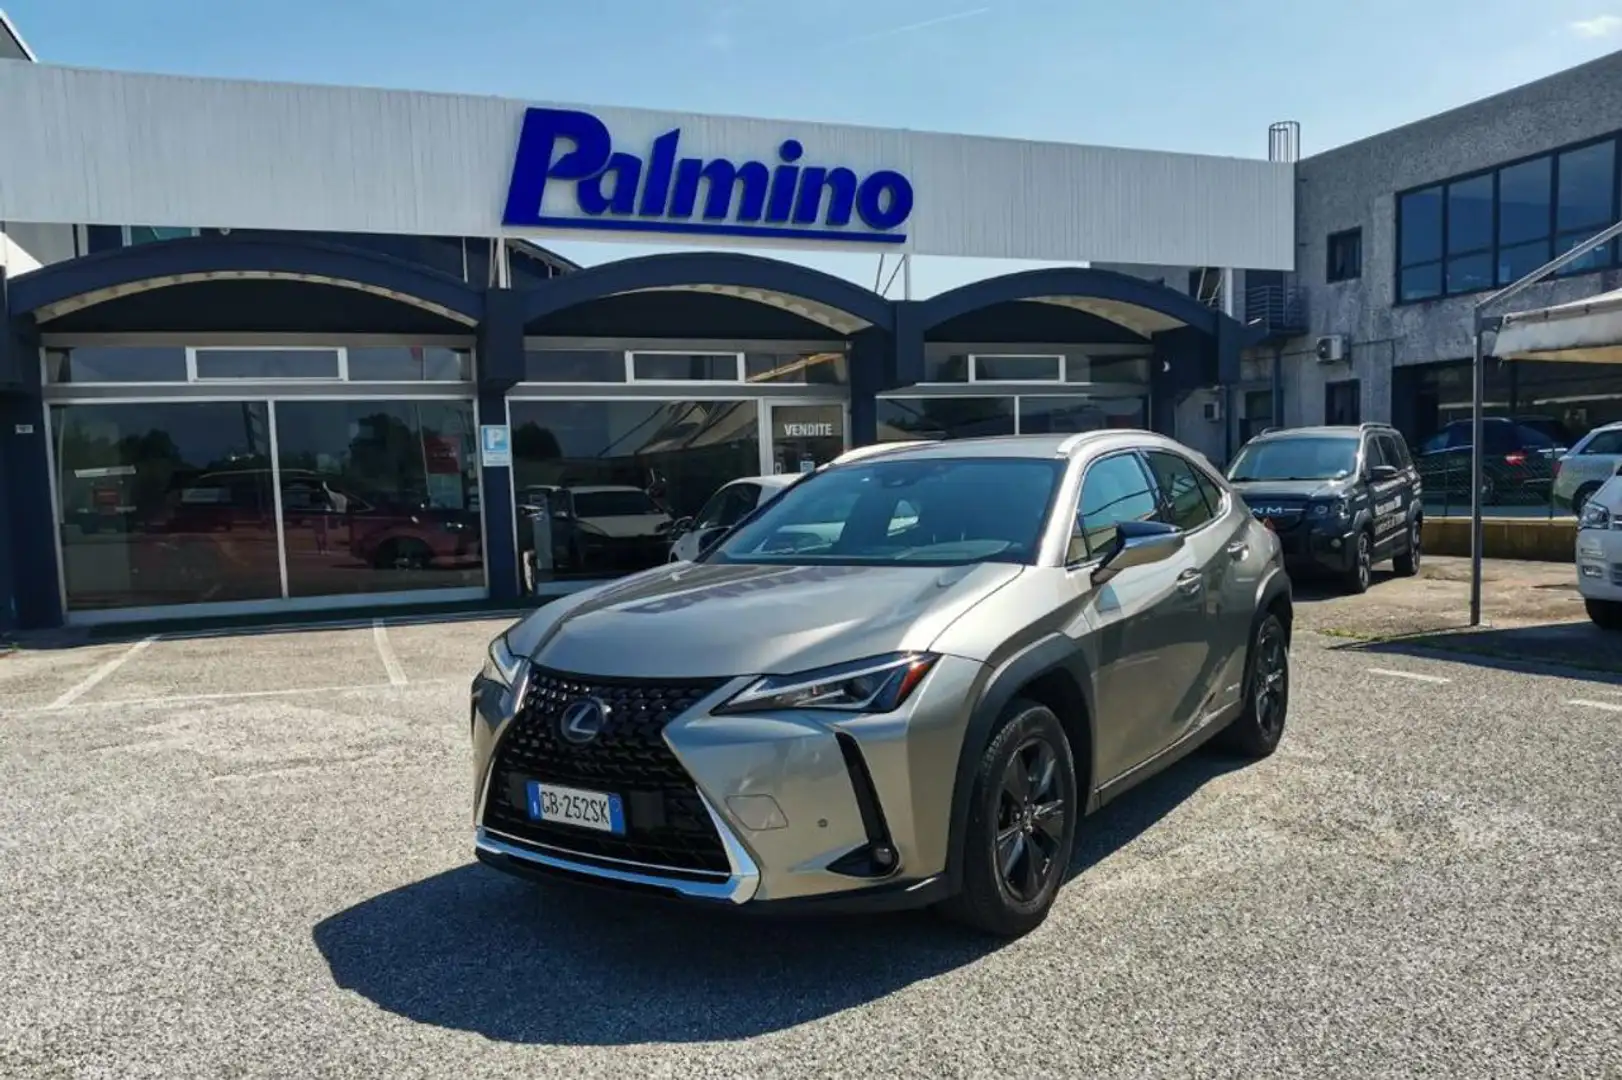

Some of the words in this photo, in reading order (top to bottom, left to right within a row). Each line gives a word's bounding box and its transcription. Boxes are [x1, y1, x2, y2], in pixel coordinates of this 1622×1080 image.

[502, 107, 914, 243] Palmino
[487, 428, 504, 449] P
[784, 423, 833, 437] VENDITE
[562, 795, 610, 825] 252SK
